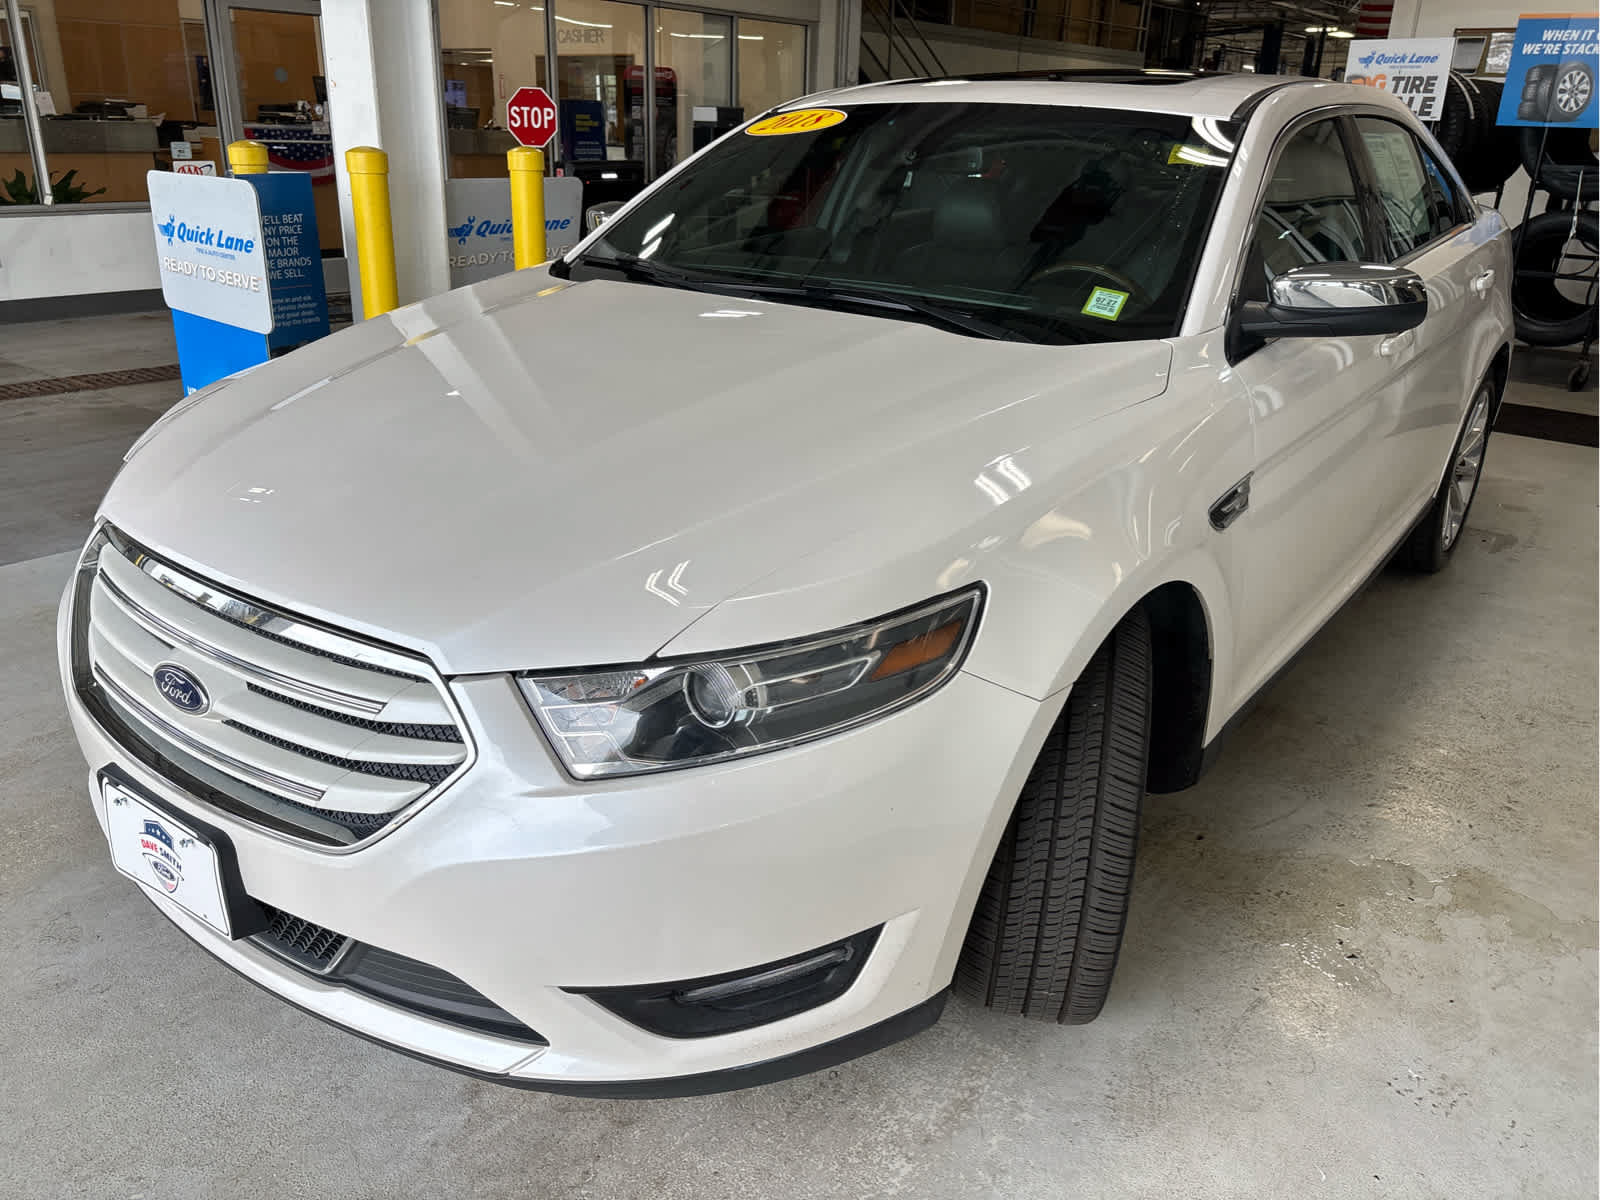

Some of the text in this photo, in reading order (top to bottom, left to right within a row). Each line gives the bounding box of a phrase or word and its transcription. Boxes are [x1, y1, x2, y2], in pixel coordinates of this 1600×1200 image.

[1542, 29, 1581, 41] WHEN
[1581, 29, 1596, 41] IT
[1522, 43, 1562, 55] WE'RE
[1376, 53, 1439, 65] Quick Lane
[1391, 75, 1439, 94] TIRE
[510, 106, 555, 129] STOP
[757, 112, 835, 131] 2018
[261, 213, 304, 225] E'LL BEAT
[476, 219, 513, 238] Quic
[177, 222, 255, 254] Quick Lane
[263, 225, 303, 236] NY PRICE
[266, 236, 299, 247] ON THE
[268, 247, 299, 257] MAJOR
[449, 251, 498, 268] READY
[545, 245, 569, 258] RVE
[278, 256, 312, 269] BRANDS
[163, 256, 260, 291] READY TO SERVE
[161, 672, 194, 704] Ford
[141, 839, 182, 872] DAVE SMITH
